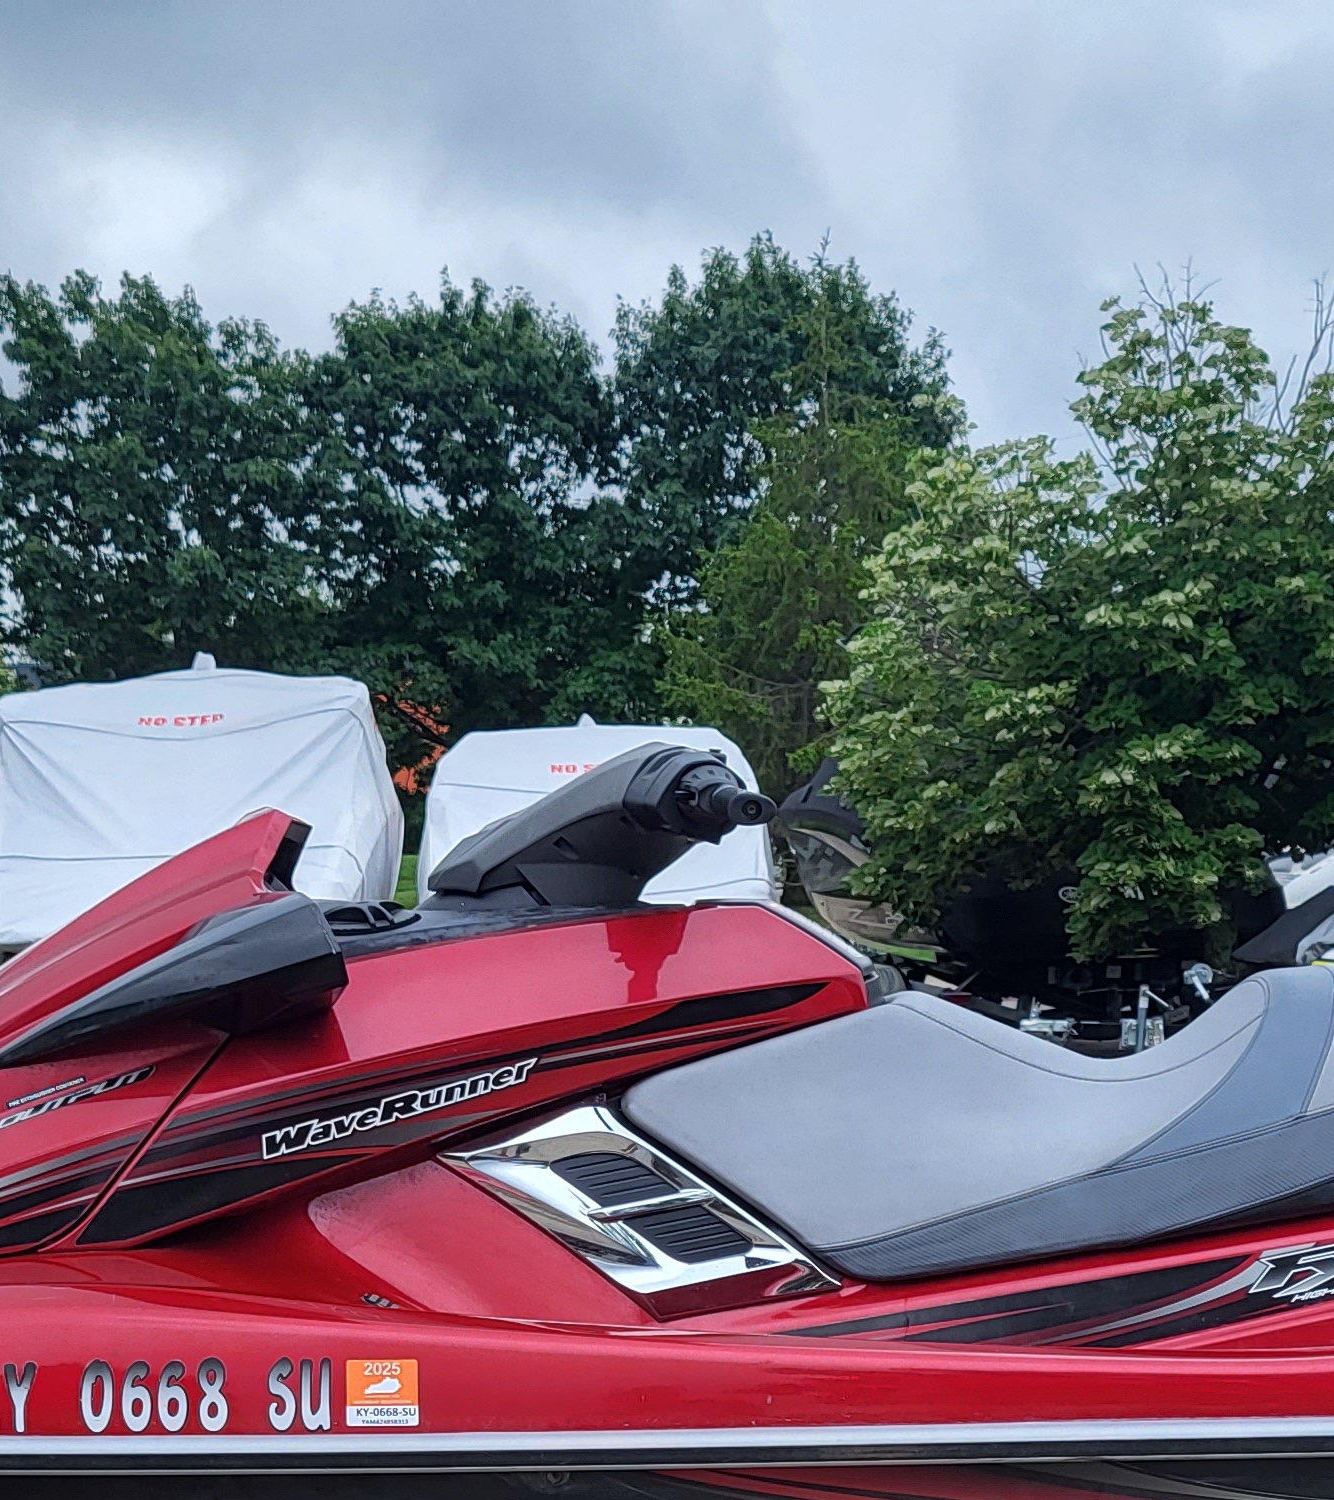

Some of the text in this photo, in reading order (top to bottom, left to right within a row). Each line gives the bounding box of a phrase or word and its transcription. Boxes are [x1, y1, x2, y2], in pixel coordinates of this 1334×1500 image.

[138, 713, 224, 727] NO STEP
[550, 764, 577, 774] NO
[261, 1056, 539, 1160] WaveRunner
[363, 1362, 401, 1376] 2025
[79, 1357, 230, 1434] 0668
[267, 1356, 332, 1432] SU
[356, 1407, 416, 1417] KY-0668-SU
